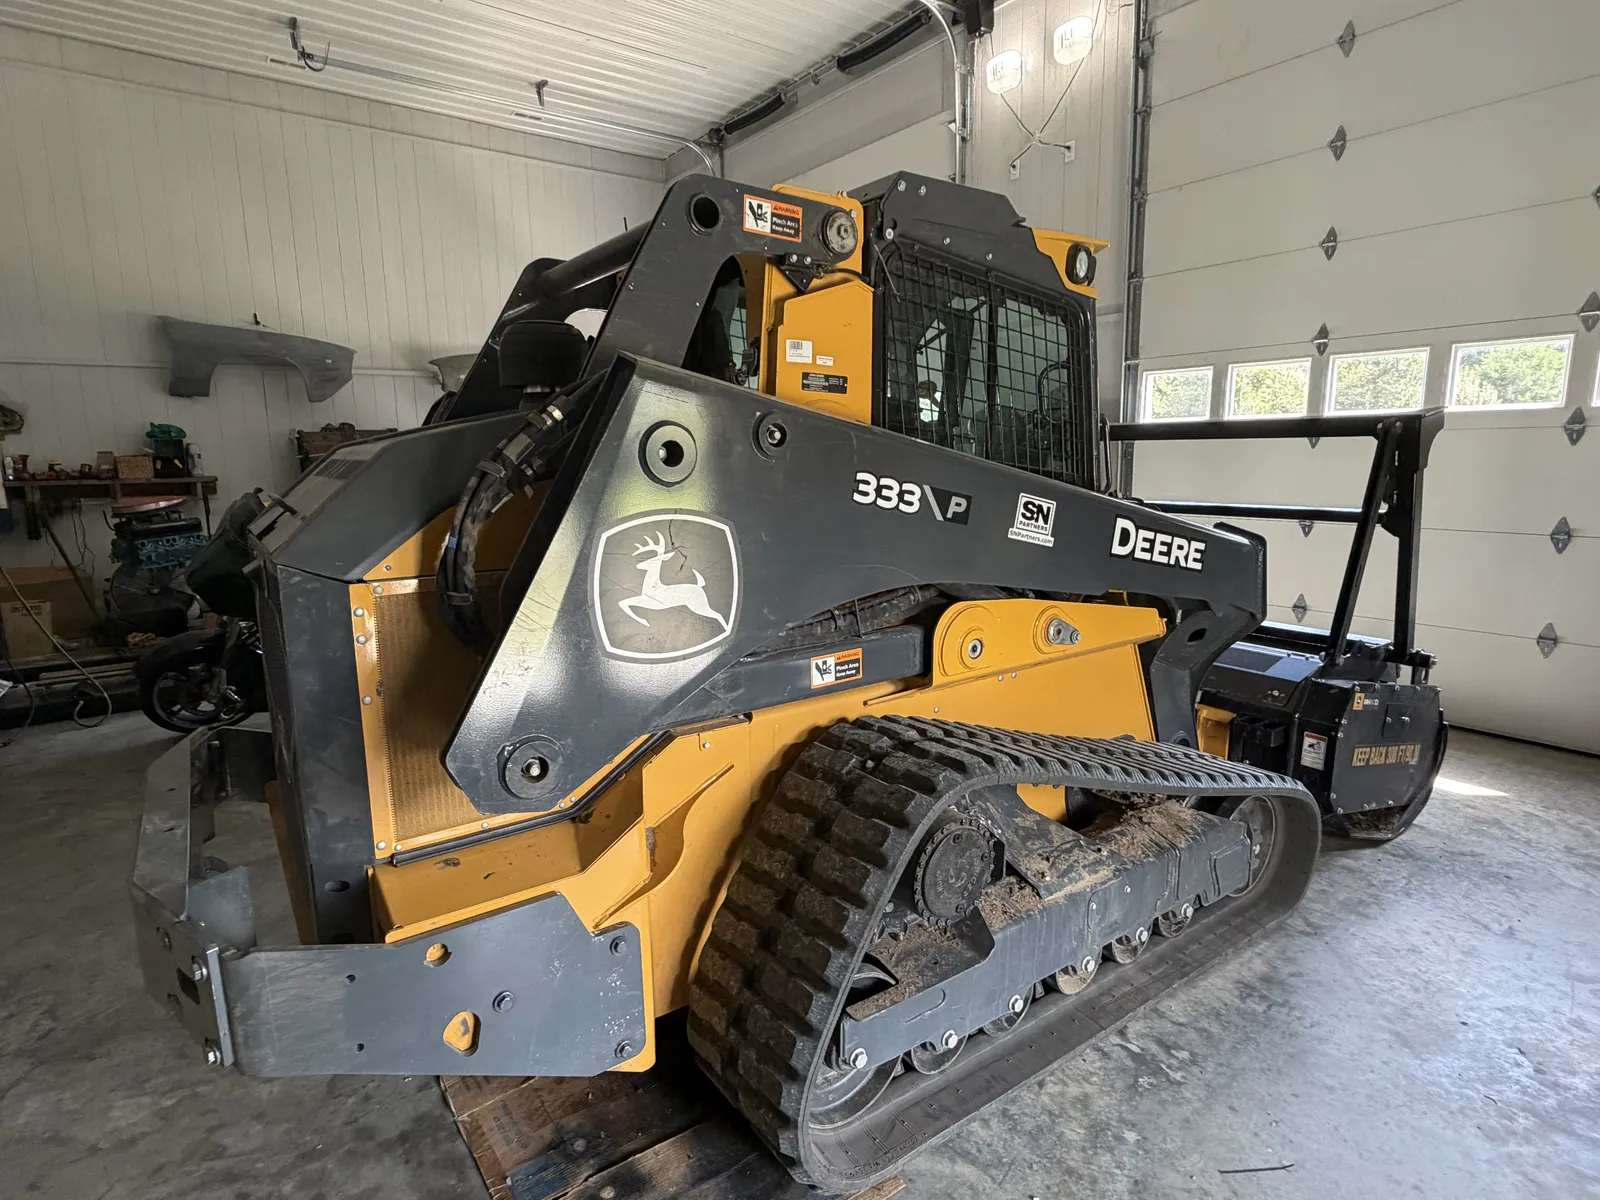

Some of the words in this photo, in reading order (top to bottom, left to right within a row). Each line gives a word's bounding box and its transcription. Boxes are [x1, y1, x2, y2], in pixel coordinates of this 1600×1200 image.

[778, 206, 799, 215] WARNING
[772, 217, 786, 225] Pinch
[784, 227, 794, 235] Away
[852, 472, 922, 514] 333
[946, 495, 968, 519] P
[1021, 500, 1051, 526] SN
[1019, 520, 1048, 532] PARTNERS
[1009, 529, 1053, 544] SNPartners.com
[1111, 517, 1206, 570] DEERE
[1352, 747, 1371, 767] KEEP
[1369, 746, 1388, 765] BACK
[1386, 745, 1399, 764] 300
